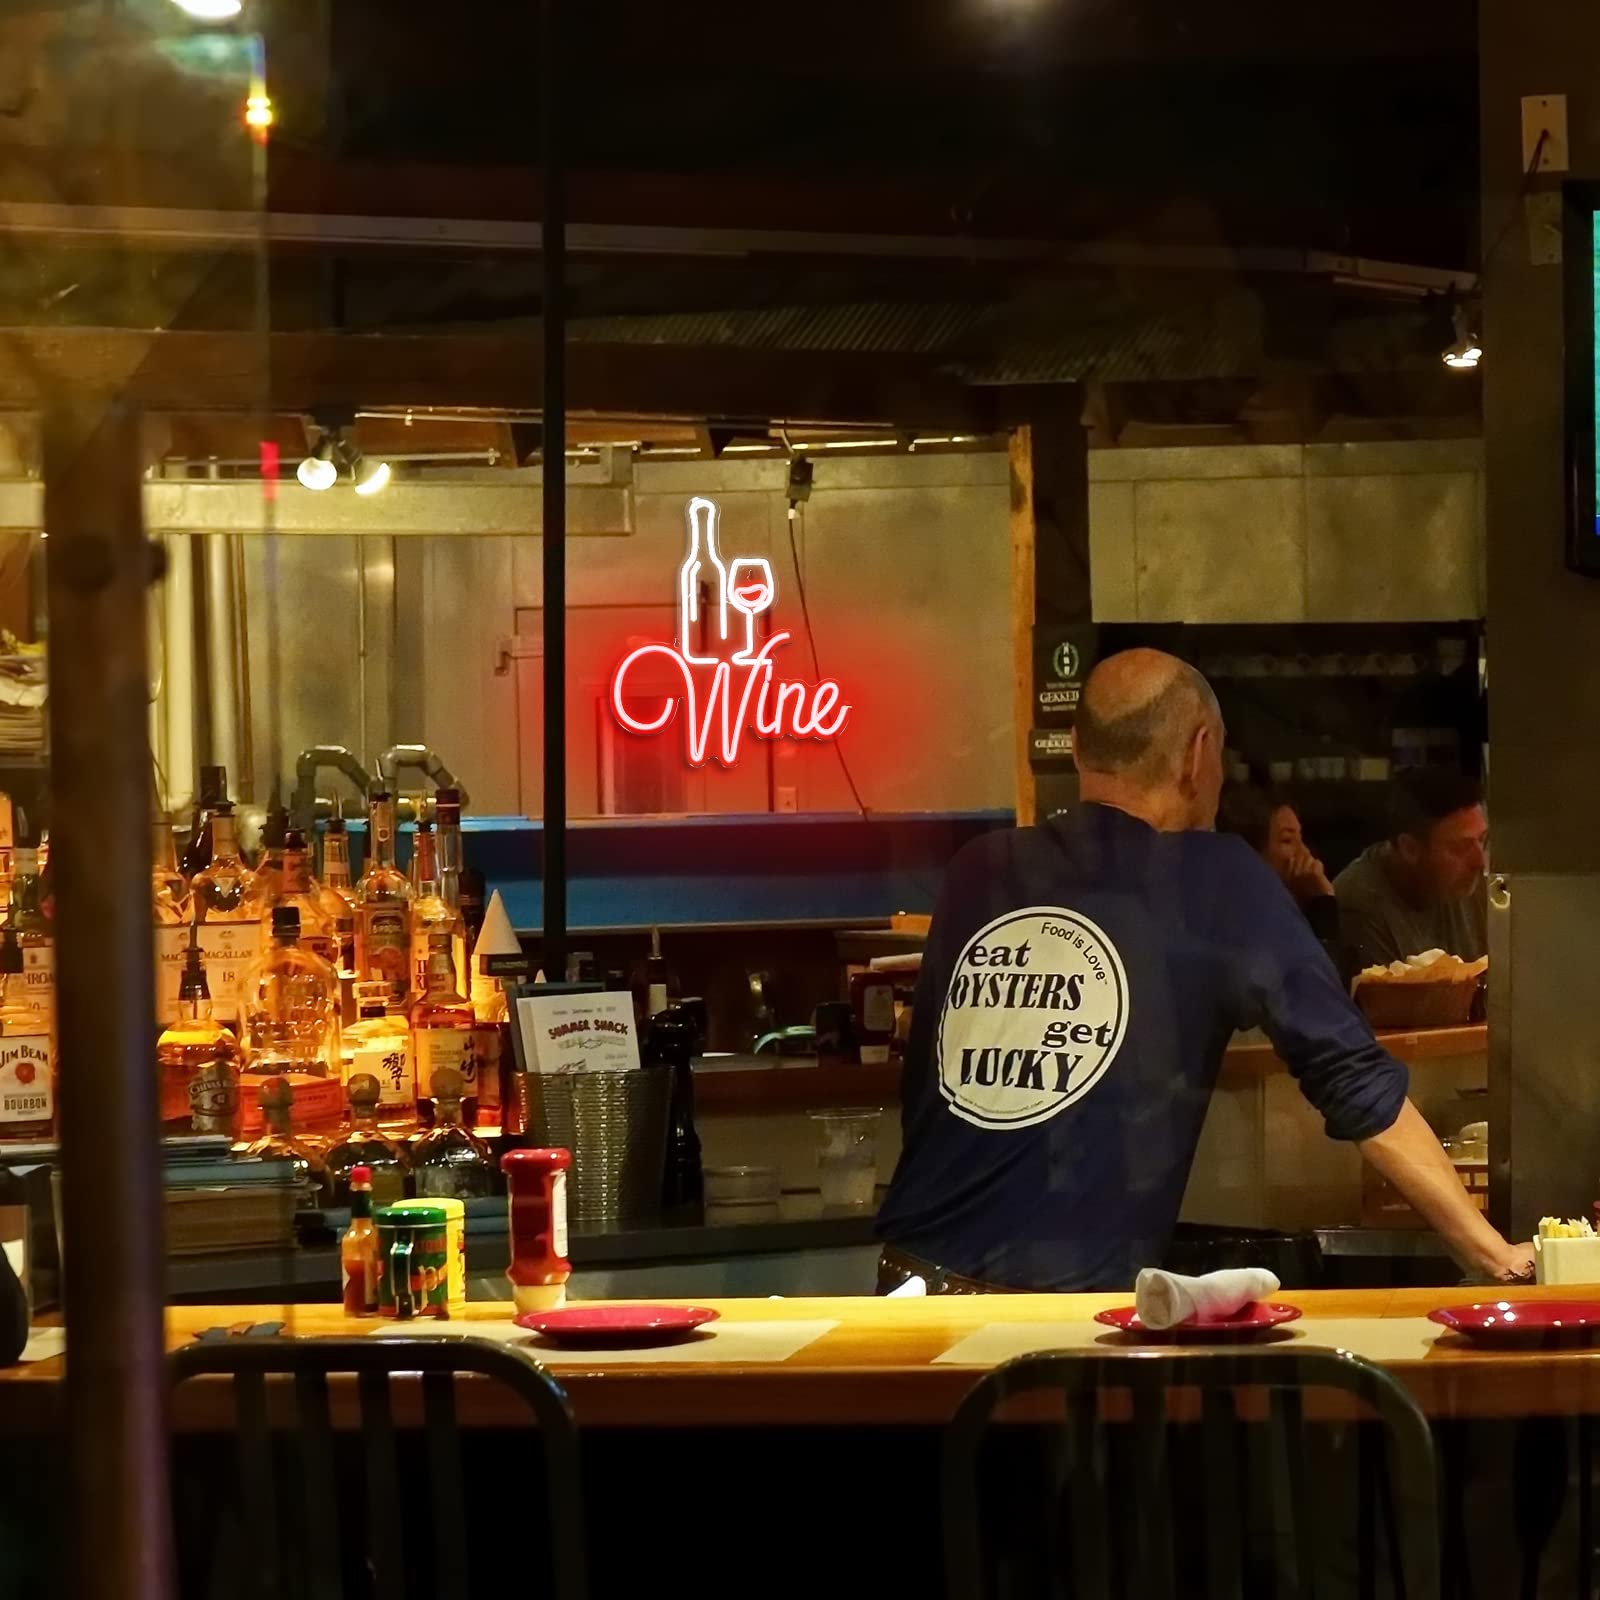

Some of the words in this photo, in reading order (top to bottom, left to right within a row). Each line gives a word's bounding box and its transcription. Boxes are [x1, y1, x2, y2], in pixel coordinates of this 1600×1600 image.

[613, 632, 850, 763] Wine
[1041, 921, 1076, 941] Food
[1072, 933, 1085, 949] is
[203, 950, 253, 960] MACALLAN
[967, 939, 1031, 967] eat
[222, 971, 236, 983] 18
[950, 972, 1085, 1010] OYSTERS
[548, 1019, 591, 1040] SUMMER
[593, 1018, 629, 1036] SHACK
[1041, 1020, 1112, 1048] get
[0, 1049, 19, 1068] JIM
[960, 1048, 1084, 1093] LUCKY
[4, 1096, 47, 1111] BOURBON
